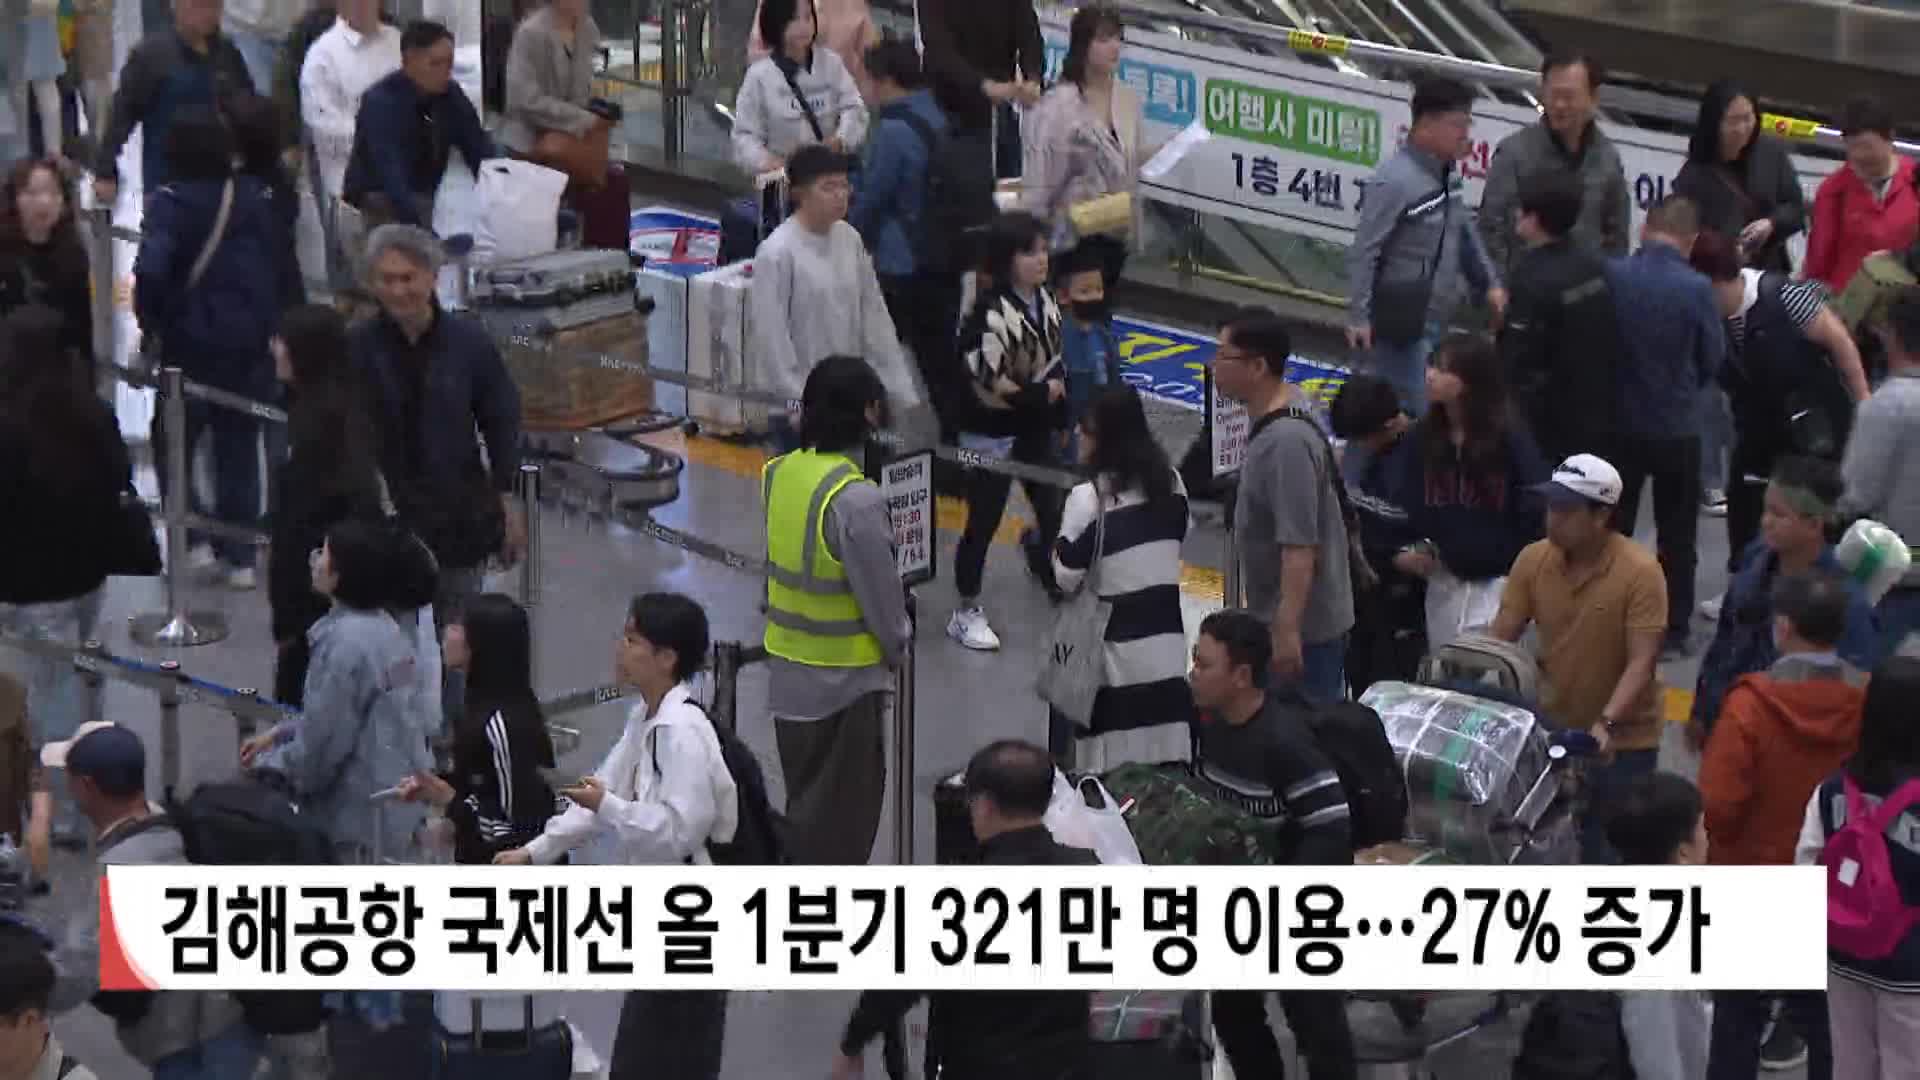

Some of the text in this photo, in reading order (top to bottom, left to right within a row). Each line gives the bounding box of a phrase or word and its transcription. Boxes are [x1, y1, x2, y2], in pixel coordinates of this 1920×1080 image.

[1209, 87, 1297, 140] 여행사
[1232, 152, 1279, 196] 1층
[1288, 167, 1345, 212] 4번
